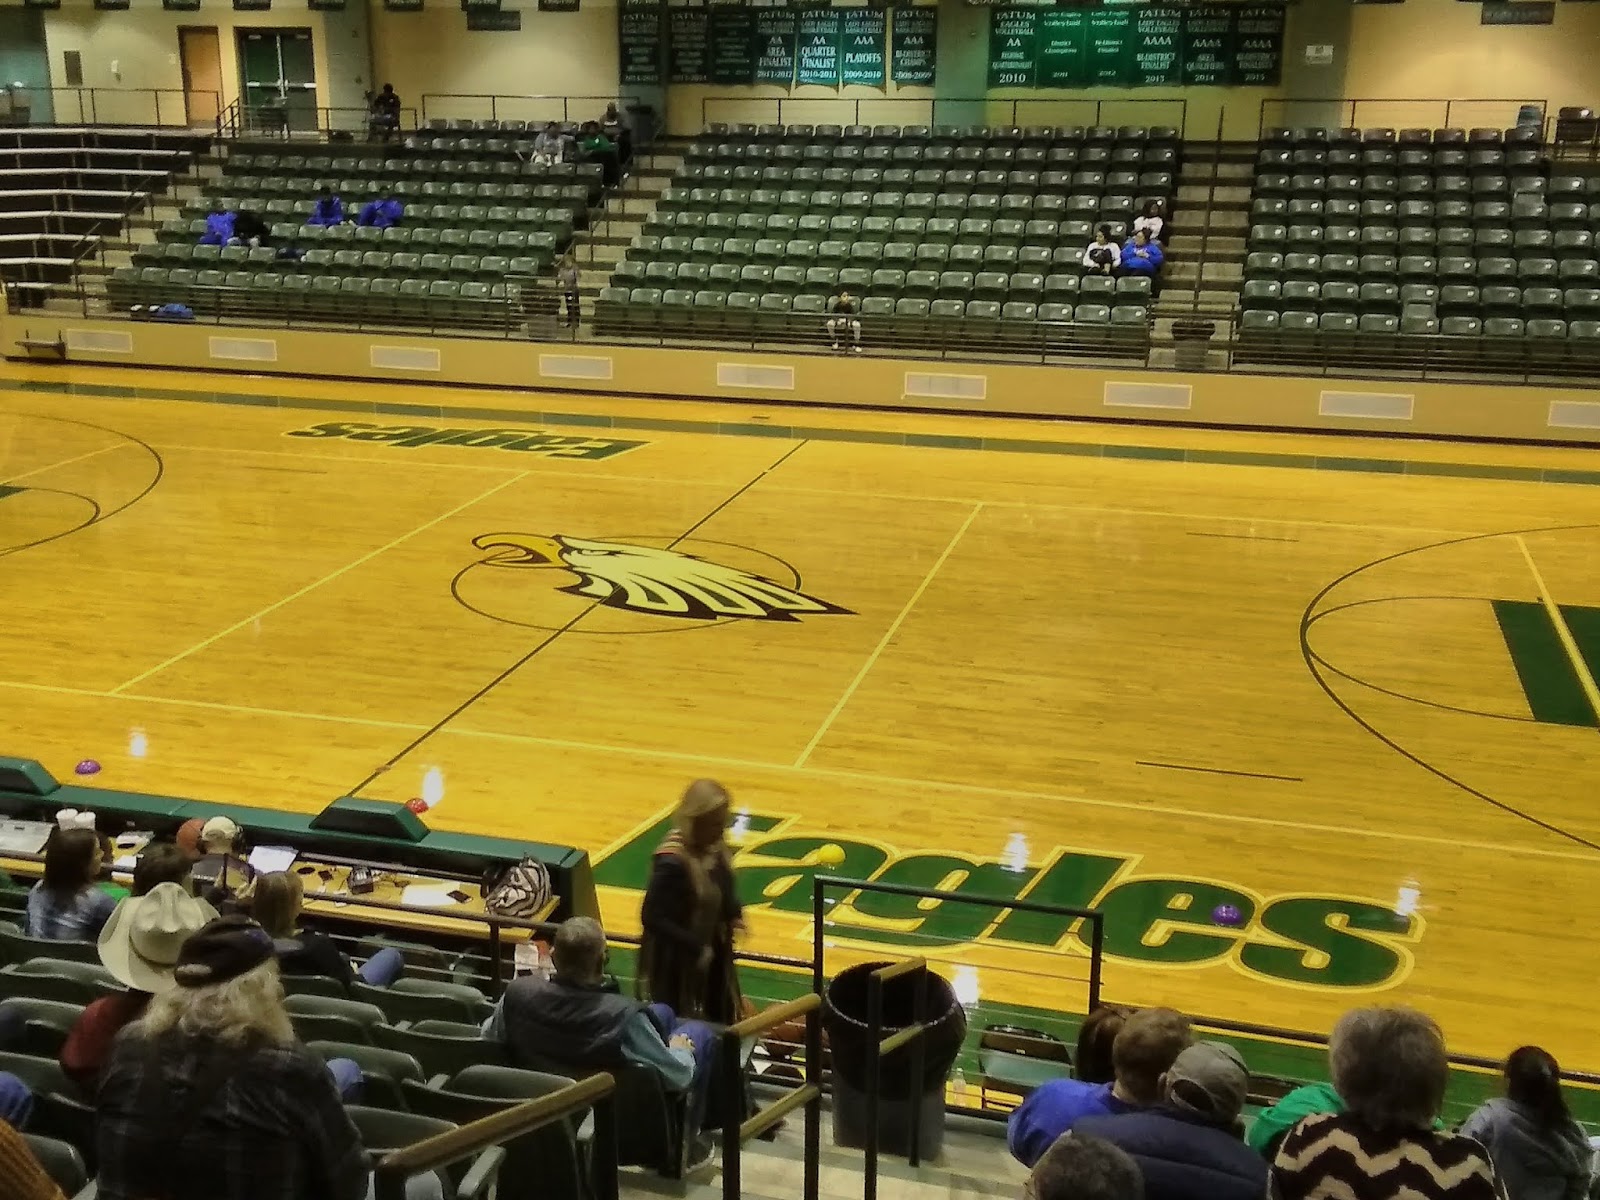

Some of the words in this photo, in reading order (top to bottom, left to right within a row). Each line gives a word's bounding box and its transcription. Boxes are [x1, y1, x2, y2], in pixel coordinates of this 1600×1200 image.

[759, 11, 795, 19] TATUM
[801, 10, 839, 19] TATUM
[846, 10, 884, 19] TATUM
[996, 11, 1035, 20] TATUM
[1139, 9, 1181, 18] TATUM
[769, 36, 783, 44] AA
[812, 36, 826, 44] AA
[854, 36, 875, 45] AAA
[903, 36, 924, 44] AAA
[1006, 38, 1021, 46] AA
[1143, 36, 1171, 45] AAAA
[766, 47, 786, 57] AREA
[802, 46, 836, 57] QUARTER
[759, 57, 792, 67] FINALIST
[845, 53, 881, 63] PLAYOFFS
[802, 58, 835, 68] FINALIST
[800, 70, 837, 78] 2010-2011
[844, 70, 882, 78] 2009-2010
[999, 73, 1026, 83] 2010
[282, 420, 652, 460] Eagles
[586, 798, 1427, 993] Eagles
